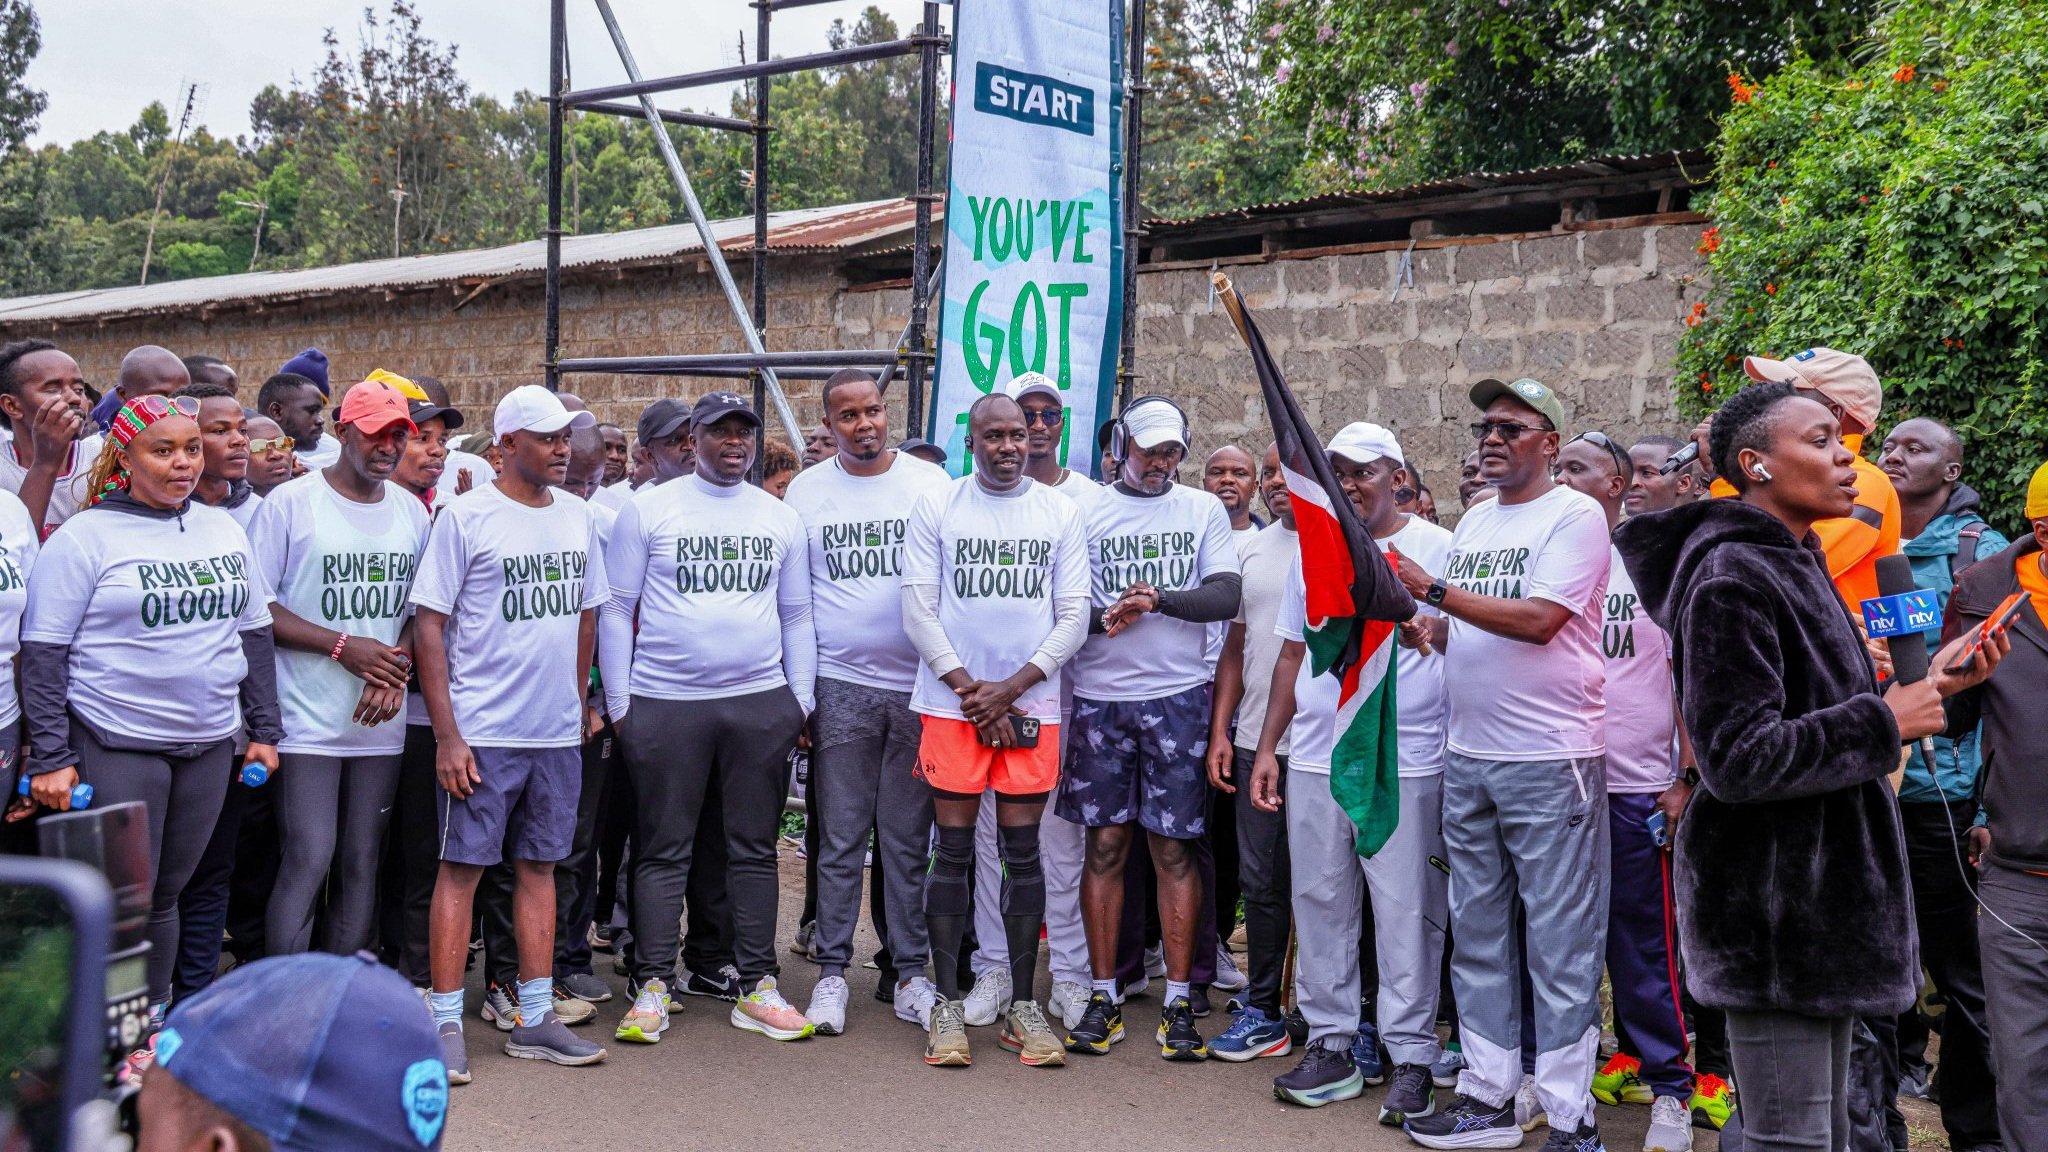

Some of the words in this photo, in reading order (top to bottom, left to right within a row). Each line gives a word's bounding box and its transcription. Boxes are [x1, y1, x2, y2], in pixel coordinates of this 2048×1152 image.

[990, 75, 1082, 123] START
[968, 196, 1094, 264] YOU'VE
[963, 279, 1088, 395] GOT
[677, 536, 718, 562] RUN
[742, 536, 773, 562] FOR
[823, 522, 862, 551] RUN
[884, 518, 909, 546] FO
[1101, 535, 1139, 563] RUN
[1162, 531, 1195, 557] FOR
[826, 547, 903, 582] OLOOLU
[955, 538, 997, 565] RUN
[1018, 539, 1051, 566] FOR
[1445, 552, 1480, 580] RUN
[1491, 548, 1529, 577] FOR
[138, 562, 193, 590] RUN
[209, 555, 248, 582] FOR
[323, 553, 364, 584] RUN
[389, 553, 415, 582] FOR
[503, 553, 542, 587] RUN
[676, 563, 772, 594] OLOOLUA
[954, 567, 1045, 599] OLOOLUA
[1603, 594, 1637, 621] OR
[1871, 617, 1894, 630] ntv
[1909, 611, 1934, 625] ntv
